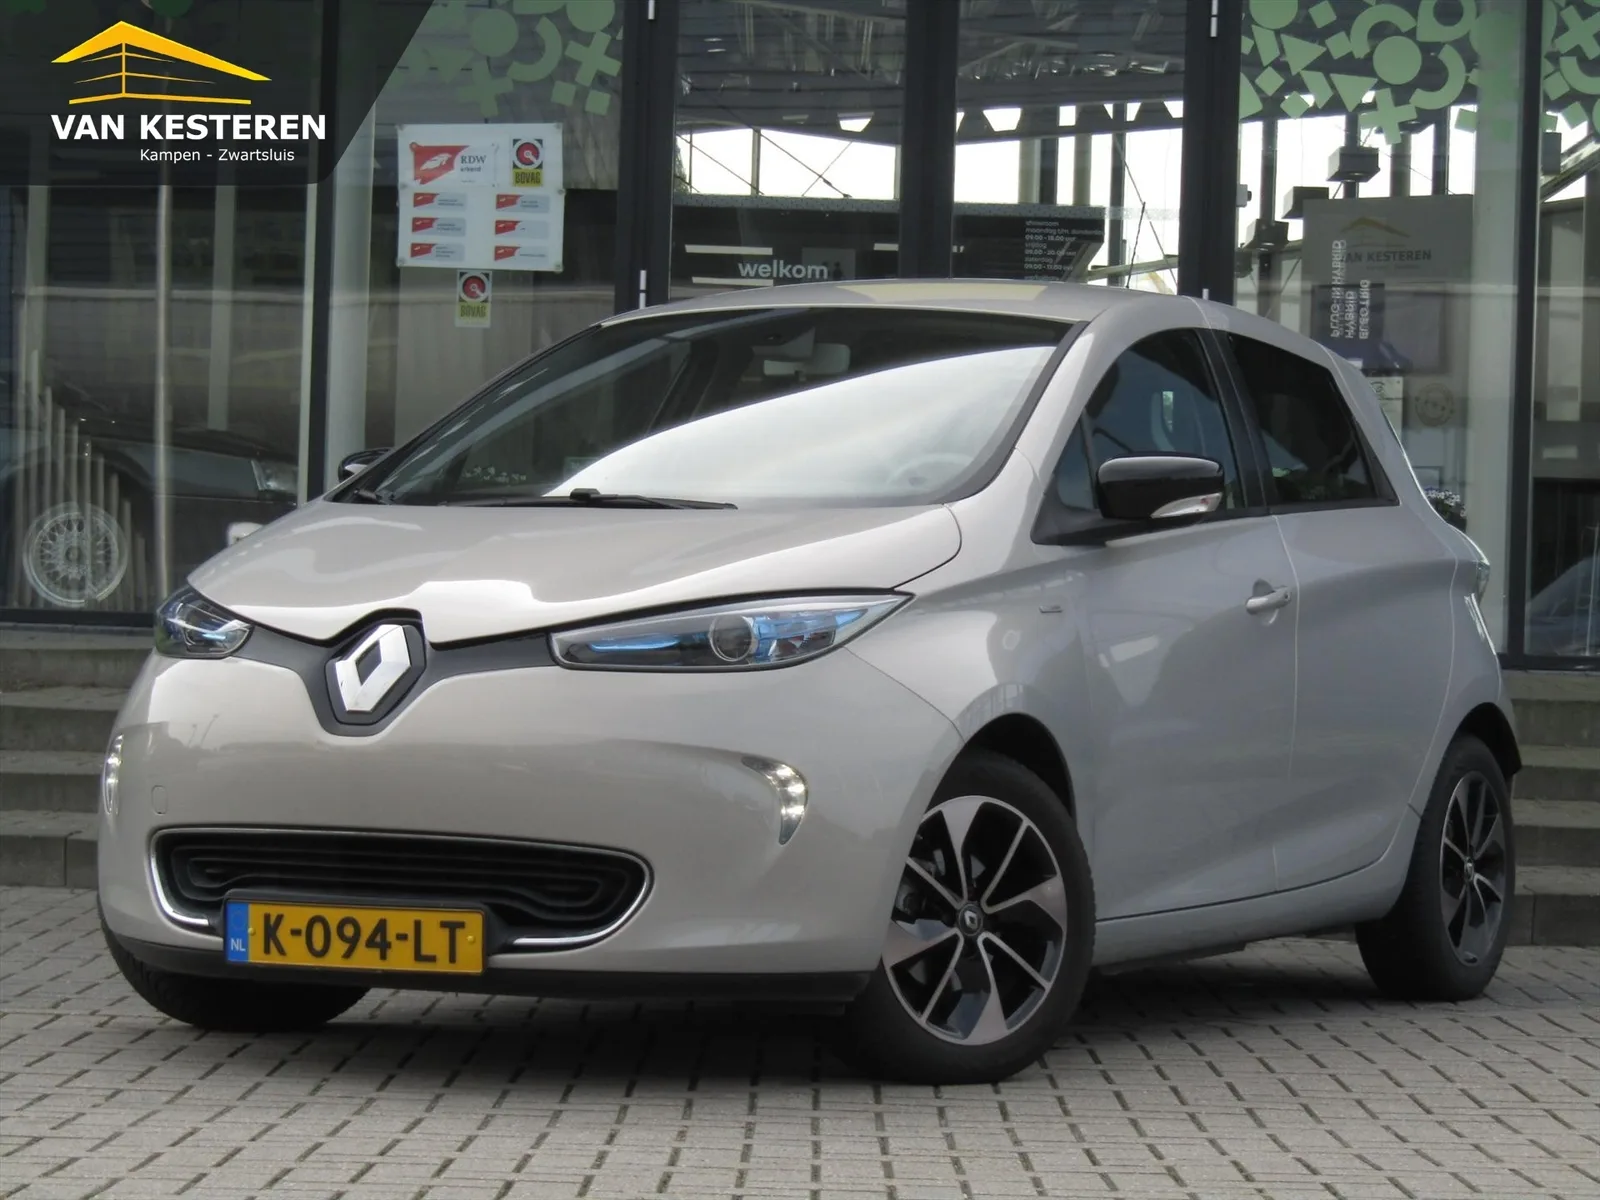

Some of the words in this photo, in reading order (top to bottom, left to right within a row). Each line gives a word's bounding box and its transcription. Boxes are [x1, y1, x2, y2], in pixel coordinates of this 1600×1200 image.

[461, 155, 487, 164] RDW
[515, 171, 541, 184] BOVAG
[1367, 248, 1432, 263] KESTEREN
[738, 259, 828, 279] welkom
[460, 304, 487, 318] BOVAG
[230, 938, 246, 952] NL
[262, 912, 466, 965] K-094-LT
